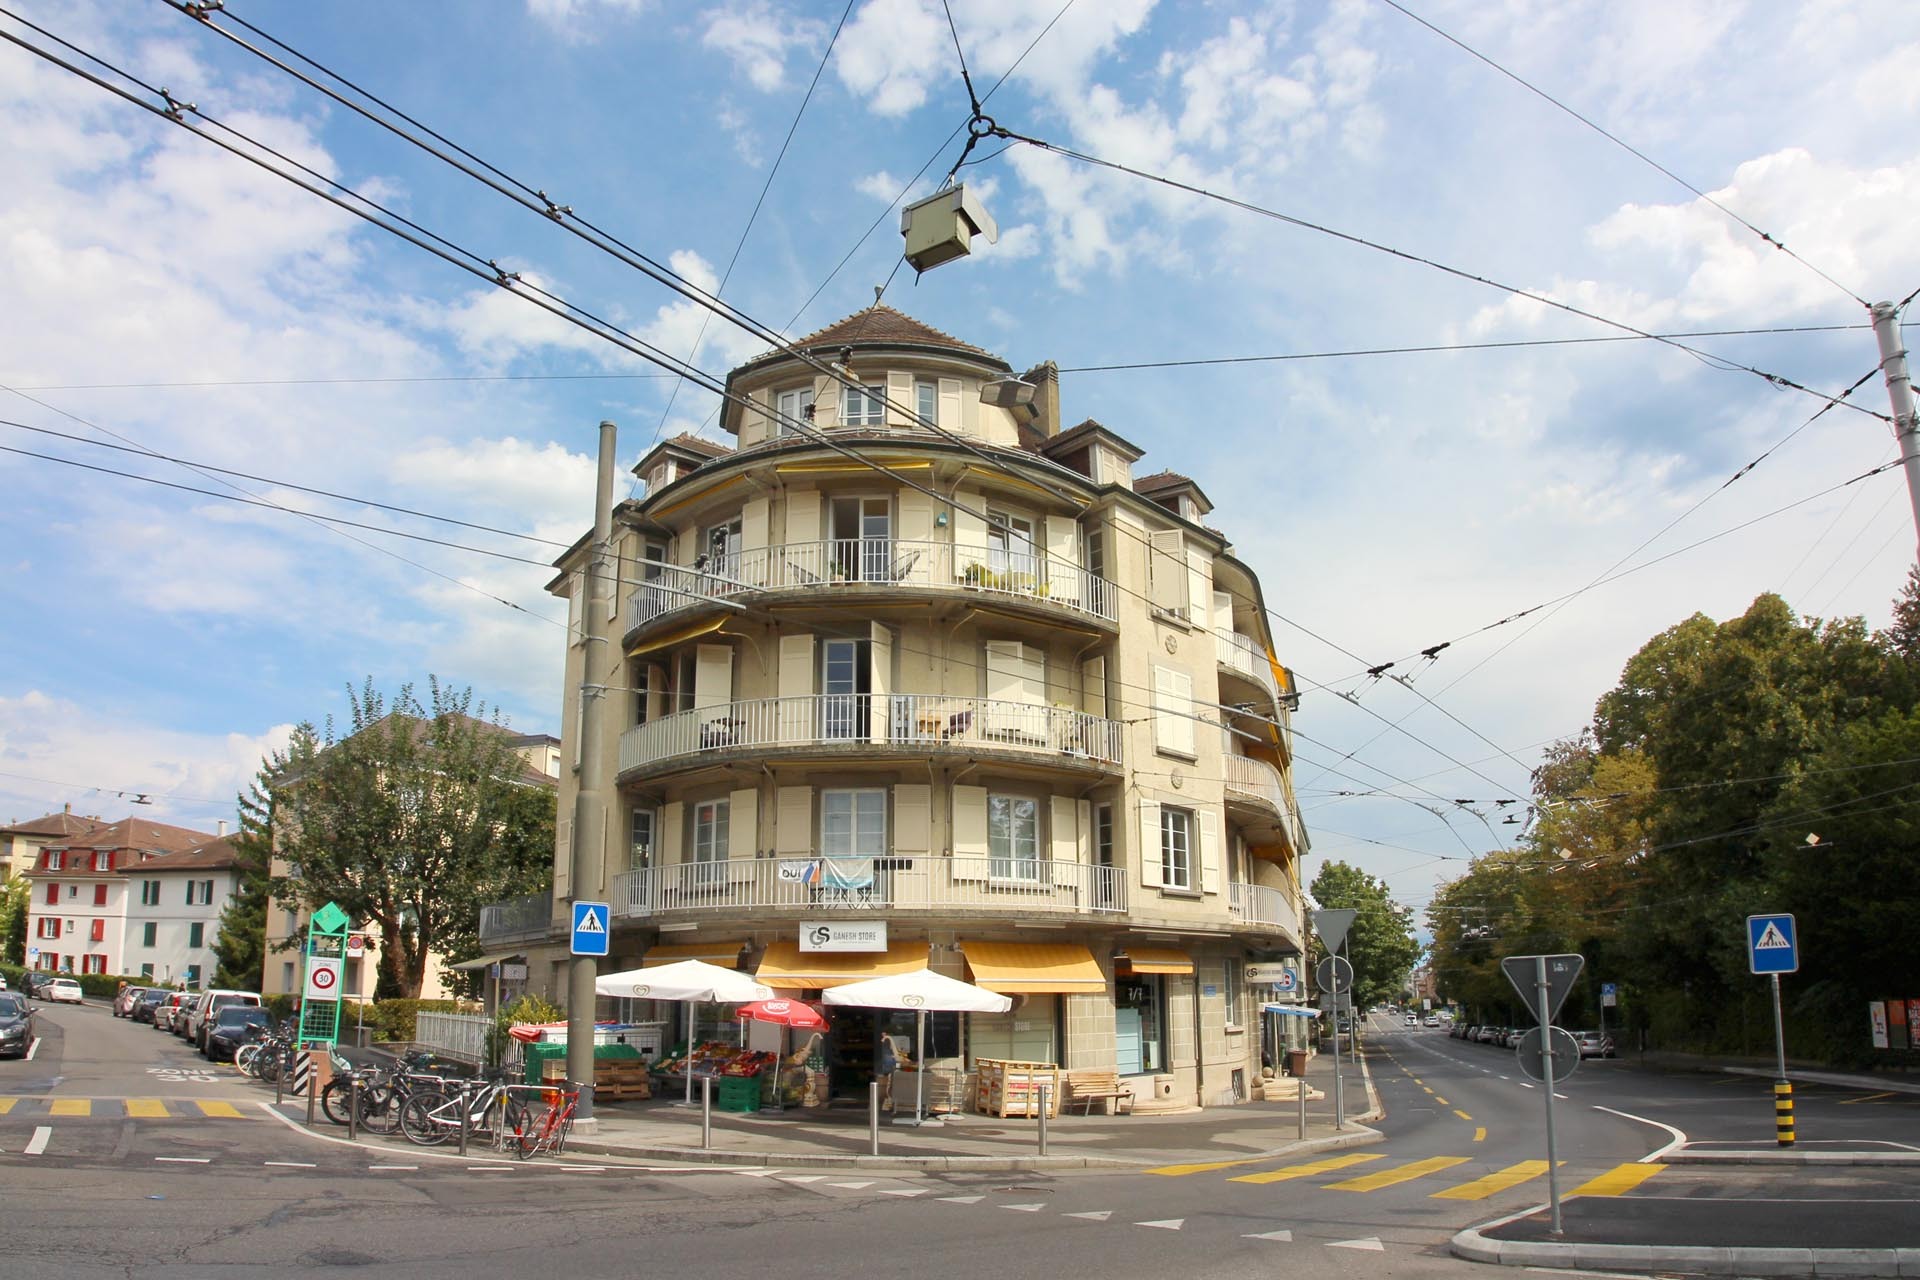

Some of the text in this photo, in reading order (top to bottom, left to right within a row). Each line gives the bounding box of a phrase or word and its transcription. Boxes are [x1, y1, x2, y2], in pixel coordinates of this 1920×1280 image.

[782, 868, 801, 878] OUI
[833, 931, 877, 941] GANESH STORE
[319, 974, 329, 983] 30
[1128, 987, 1143, 1001] 7/7
[145, 1067, 216, 1075] ZONE
